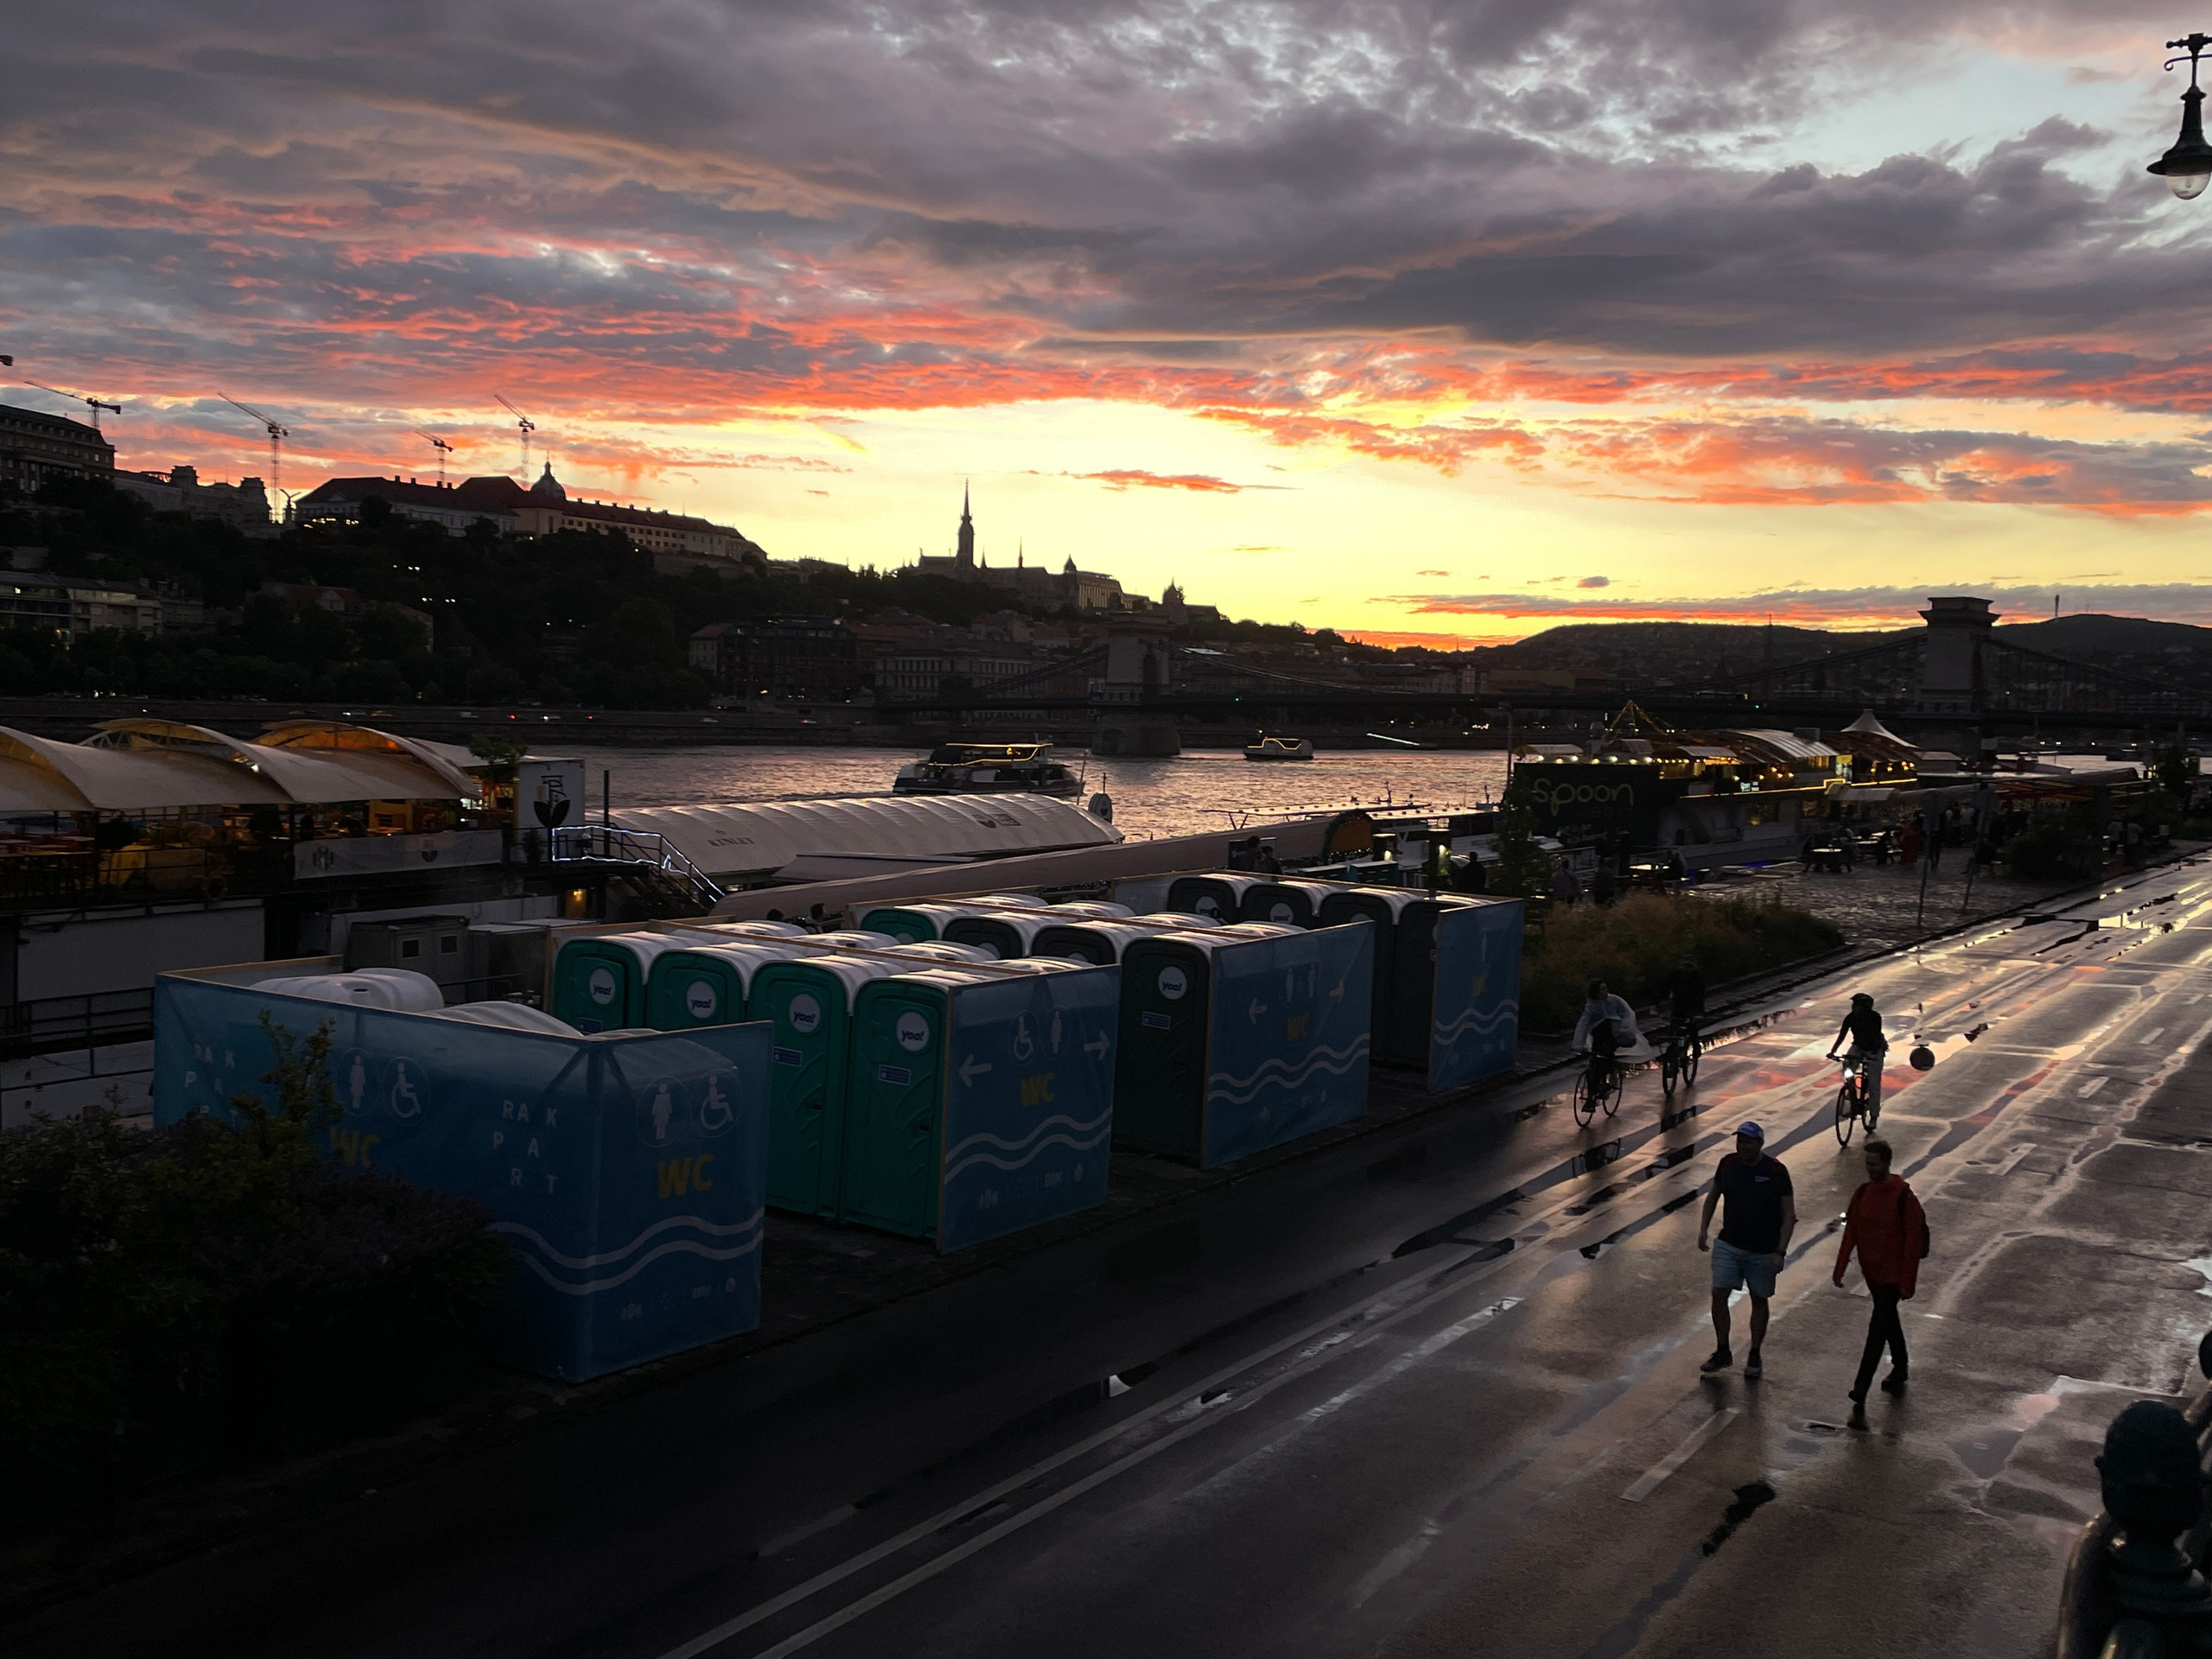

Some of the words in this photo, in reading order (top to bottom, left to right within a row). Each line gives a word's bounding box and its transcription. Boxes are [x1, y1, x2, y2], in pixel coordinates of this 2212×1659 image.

[1020, 1071, 1056, 1107] WC
[330, 1126, 381, 1169] WC
[658, 1153, 715, 1199] WC
